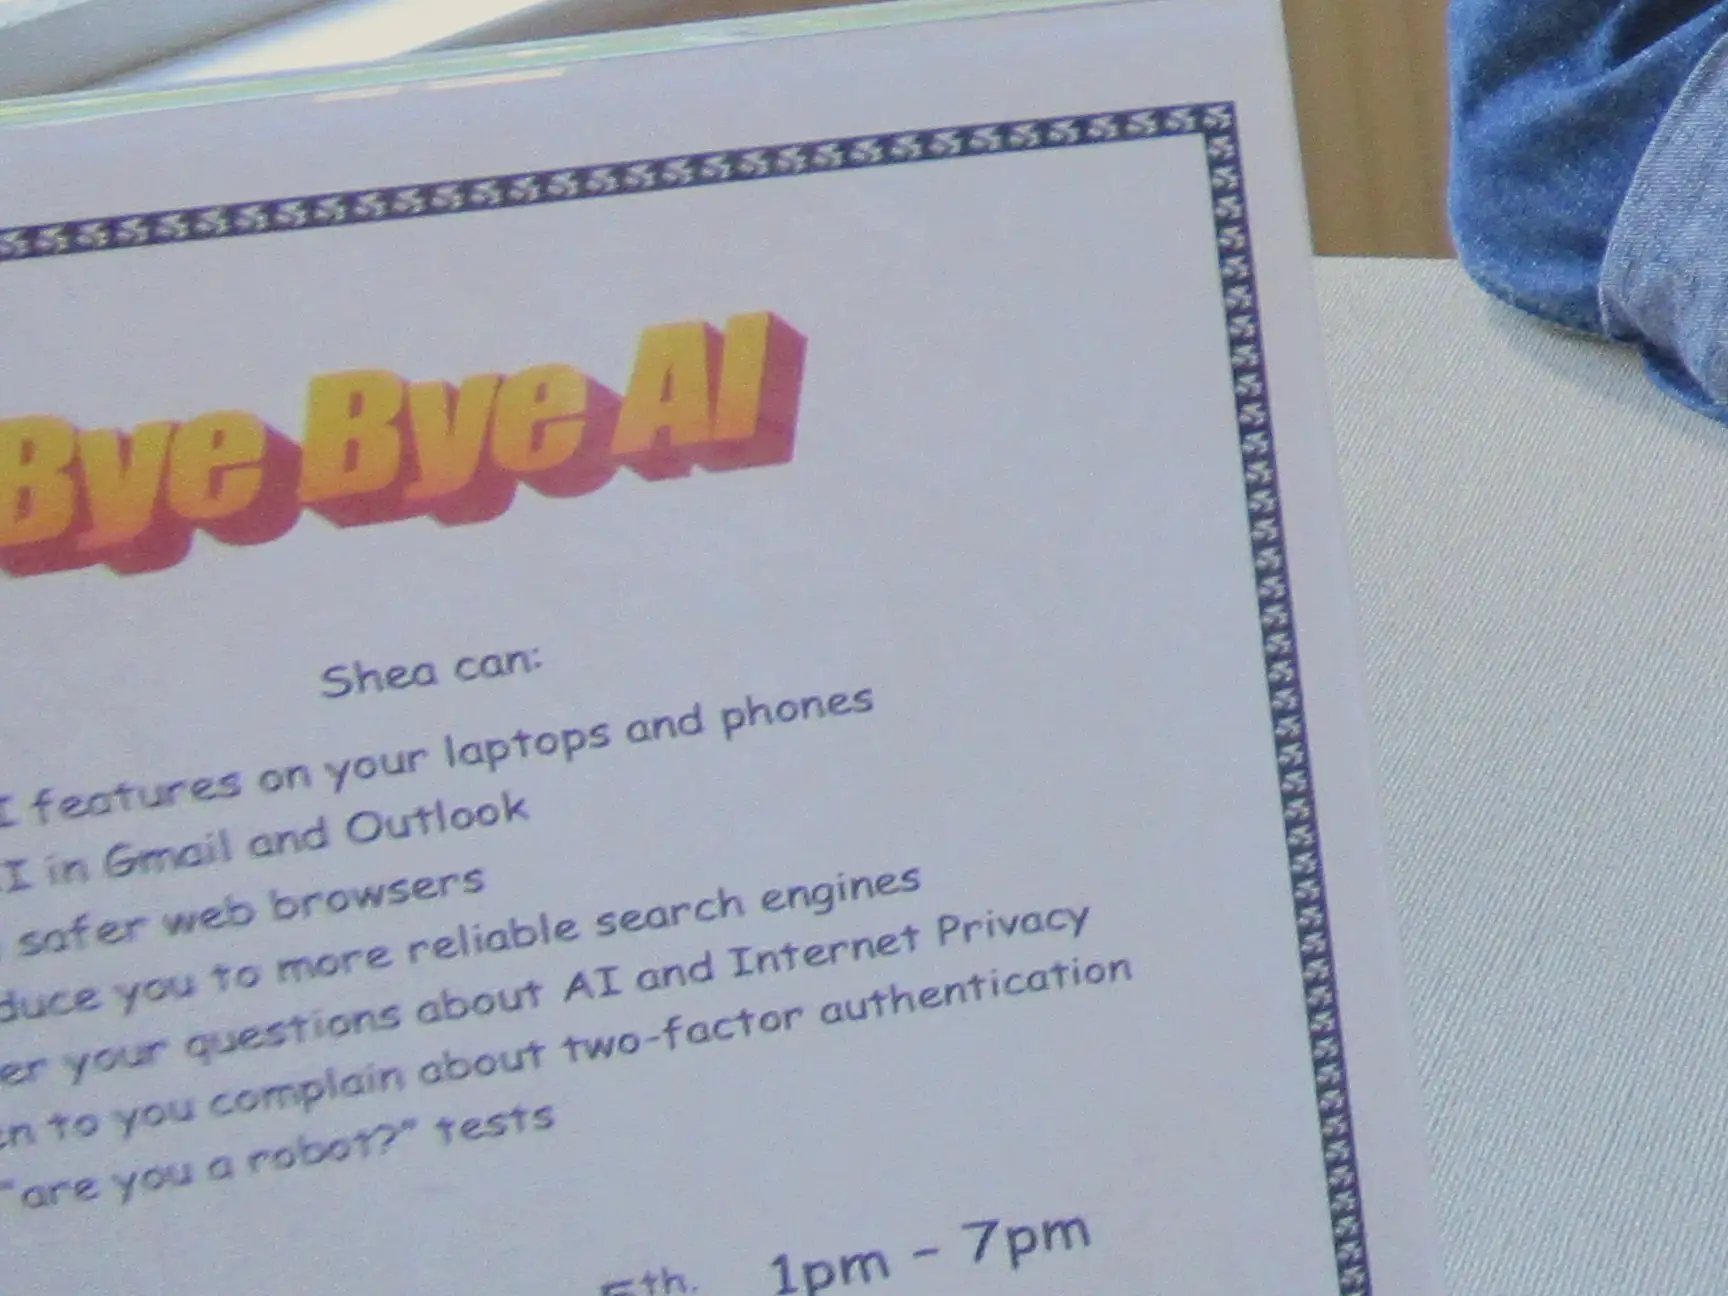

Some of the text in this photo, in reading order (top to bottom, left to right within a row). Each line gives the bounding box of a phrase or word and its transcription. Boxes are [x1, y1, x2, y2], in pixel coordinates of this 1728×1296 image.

[0, 310, 809, 578] Bye Bye AI
[321, 647, 543, 699] Shea can:
[31, 770, 243, 826] features
[259, 763, 313, 794] on
[325, 747, 429, 793] your
[444, 721, 612, 772] laptops
[626, 702, 704, 745] and
[721, 688, 875, 742] phones
[47, 854, 89, 886] in
[105, 829, 233, 879] Gmail
[248, 816, 330, 860] and
[346, 791, 531, 845] Outlook
[18, 866, 485, 958] safer web browsers
[114, 974, 197, 1017] you
[211, 962, 262, 993] to
[277, 944, 395, 985] more
[408, 912, 581, 965] reliable
[596, 886, 747, 937] search
[761, 866, 922, 915] engines
[48, 1110, 99, 1141] to
[112, 1097, 197, 1141] you
[209, 1062, 406, 1117] complain
[419, 1040, 546, 1086] about
[562, 1004, 804, 1063] two-factor
[820, 957, 1133, 1027] authentication
[63, 1039, 170, 1086] your
[186, 1004, 403, 1067] questions
[416, 980, 543, 1026] about
[564, 965, 623, 1003] AI
[636, 949, 715, 992] and
[728, 924, 921, 980] Internet
[937, 905, 1091, 948] Privacy
[112, 1162, 196, 1206] you
[208, 1155, 235, 1182] a
[247, 1116, 418, 1175] robot?"
[435, 1104, 555, 1145] tests
[770, 1249, 890, 1296] 1pm
[962, 1214, 1092, 1271] 7pm
